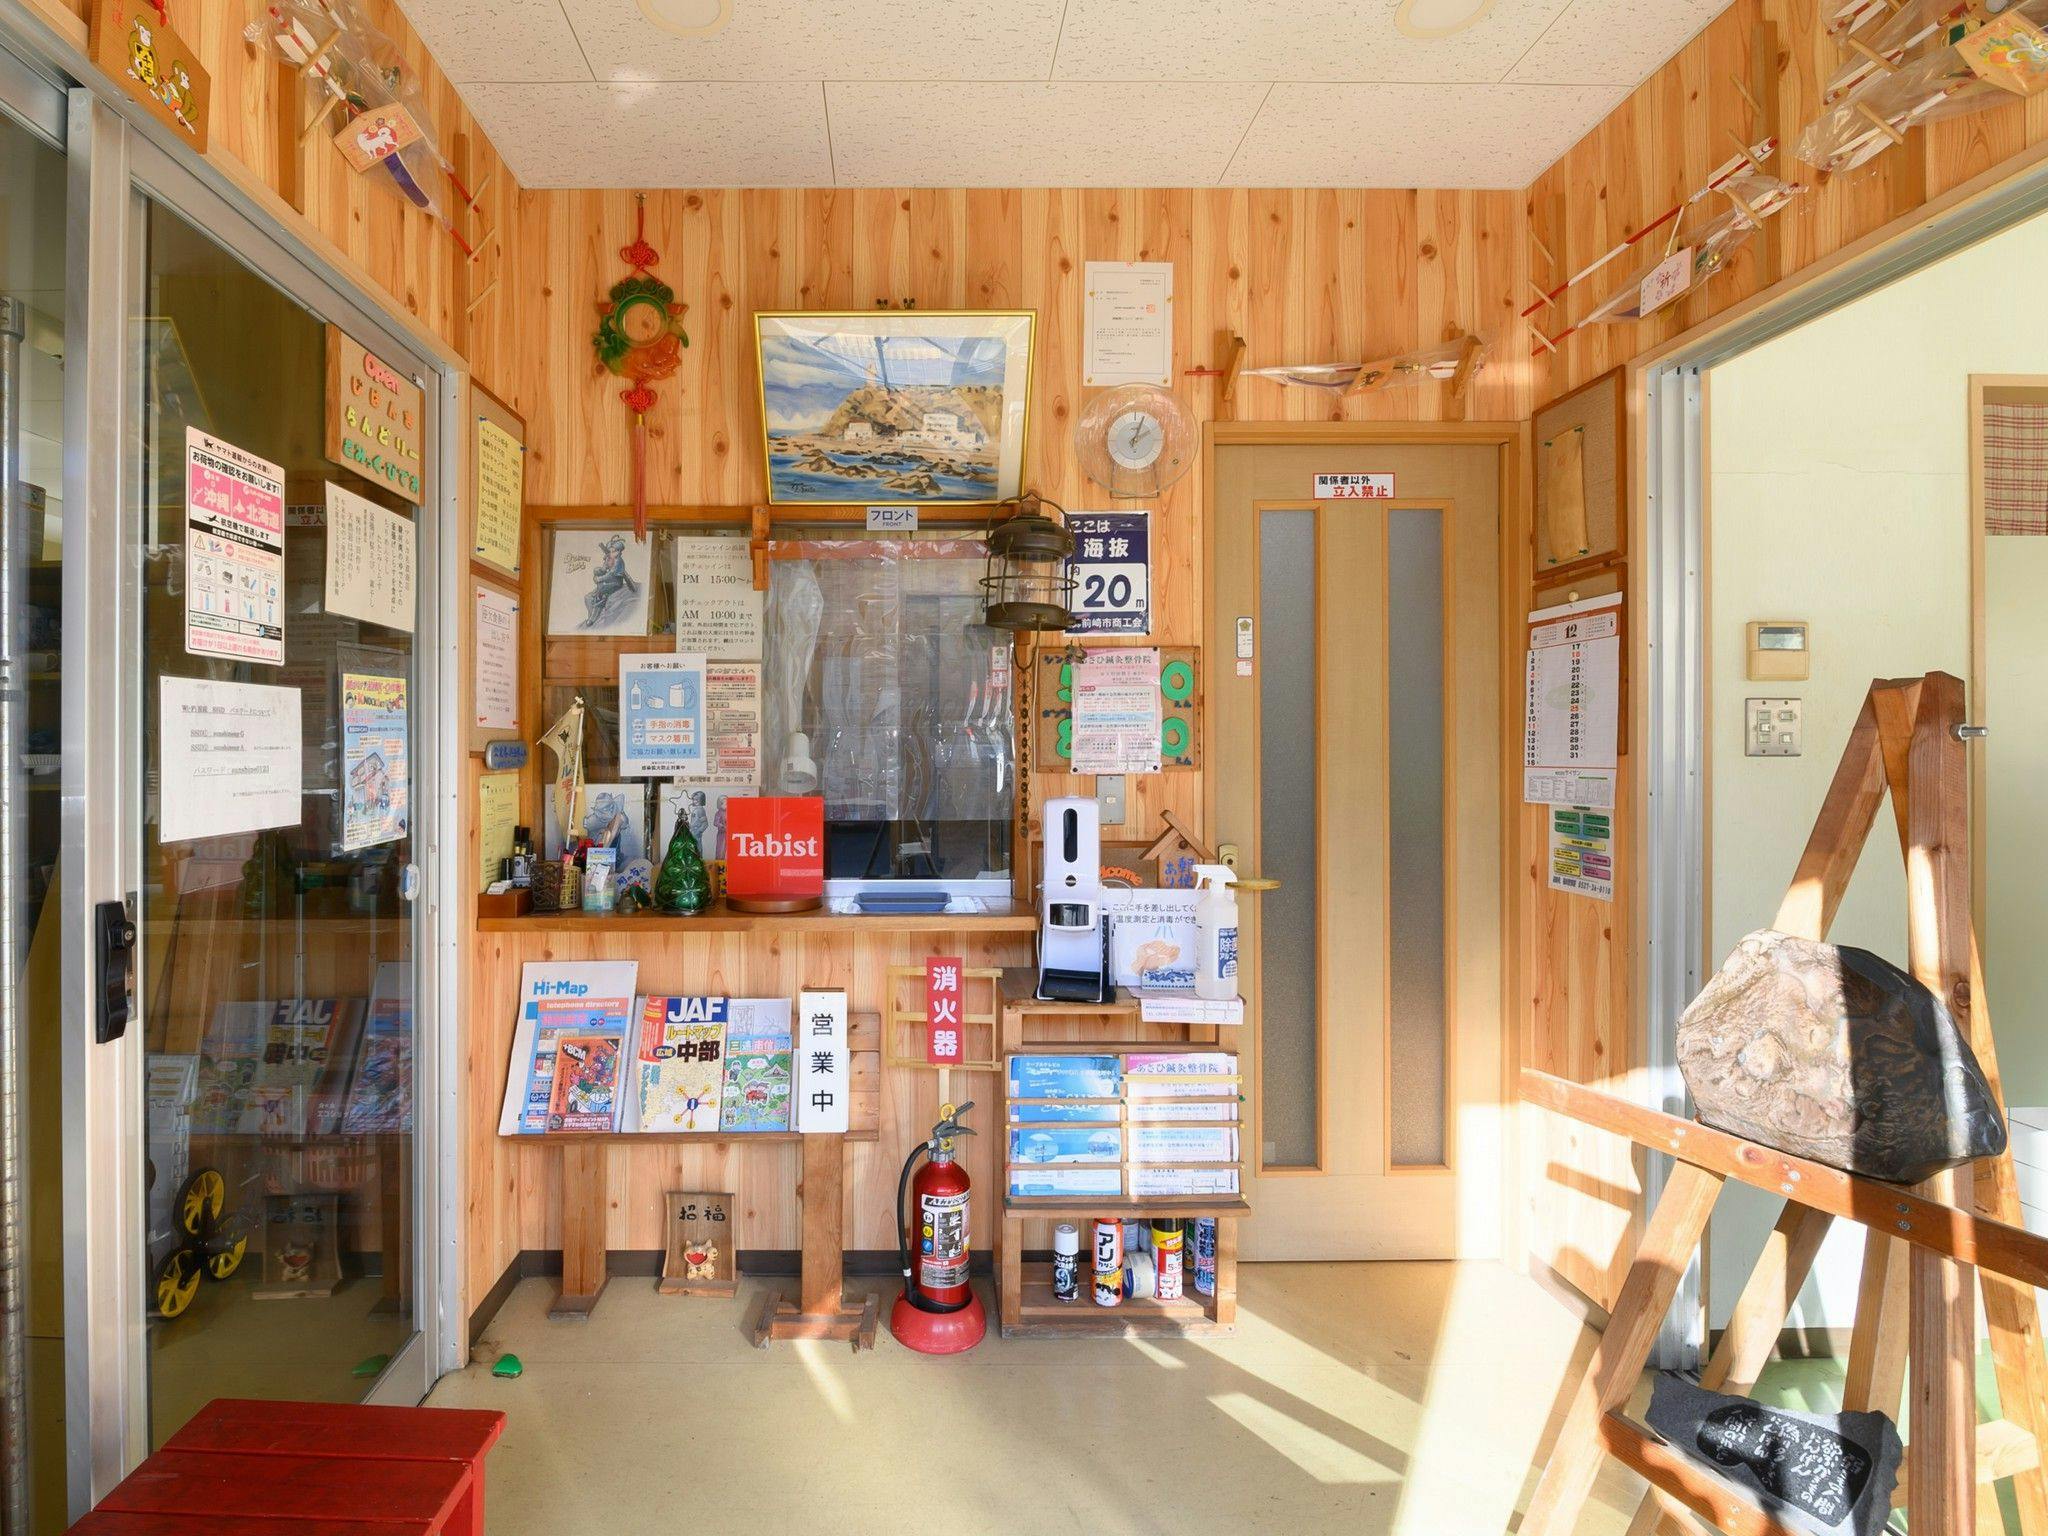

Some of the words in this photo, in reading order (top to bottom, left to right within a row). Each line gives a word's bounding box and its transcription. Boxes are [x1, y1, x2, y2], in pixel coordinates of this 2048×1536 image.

[363, 352, 400, 394] Open
[346, 404, 419, 460] らんどりー
[1319, 476, 1370, 485] 関係者以外
[204, 487, 230, 513] 沖縄
[1333, 485, 1388, 498] 立入禁止
[246, 503, 279, 530] 北海道
[870, 510, 914, 522] フロント
[1069, 520, 1111, 534] ここは
[1083, 537, 1129, 558] 海抜
[682, 575, 699, 584] PM
[1083, 574, 1132, 608] 20
[1135, 598, 1145, 608] m
[681, 610, 699, 619] AM
[710, 611, 736, 620] 10:00
[1564, 623, 1578, 639] 12
[650, 719, 691, 730] 手指の消毒
[650, 734, 691, 744] マスク着用
[731, 832, 818, 858] Tabist
[533, 981, 589, 997] Hi-Map
[668, 997, 724, 1023] JAF
[932, 965, 958, 1057] 消火器
[667, 1023, 722, 1040] ルートマップ
[677, 1040, 721, 1063] 中部
[811, 1013, 834, 1113] 営業中
[1136, 1063, 1219, 1074] あさひ鍼灸整骨院
[679, 1204, 726, 1222] 招福
